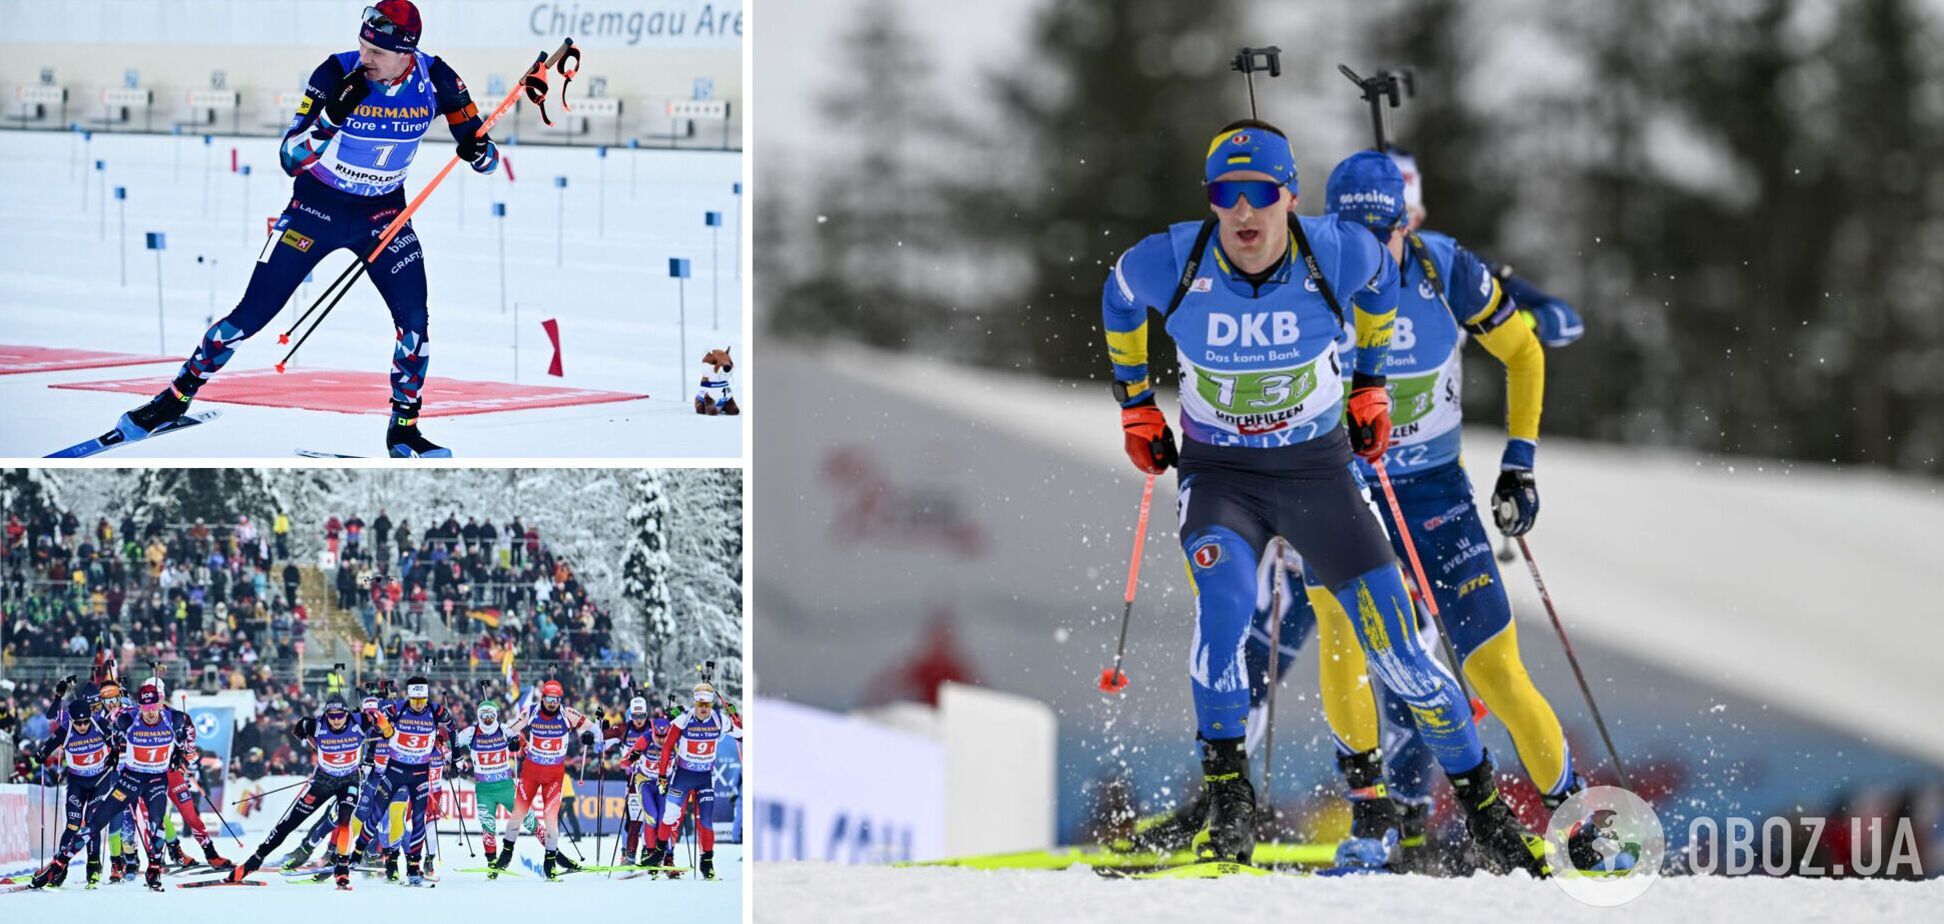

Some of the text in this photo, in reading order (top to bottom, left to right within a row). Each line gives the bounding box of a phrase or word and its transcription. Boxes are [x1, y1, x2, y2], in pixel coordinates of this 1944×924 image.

[529, 3, 687, 45] Chiemgau
[345, 117, 429, 133] Tore Türen
[372, 143, 397, 168] 1
[300, 203, 332, 222] LAPUA
[1206, 310, 1300, 348] DKB
[1205, 347, 1301, 363] Das kann Bank
[1386, 355, 1416, 367] Bank
[1208, 373, 1296, 408] 13
[406, 735, 420, 748] 3
[540, 739, 552, 750] 6
[697, 742, 708, 754] 9
[83, 753, 95, 764] 4
[146, 748, 158, 762] 1
[332, 753, 346, 764] 2
[480, 752, 501, 764] 14
